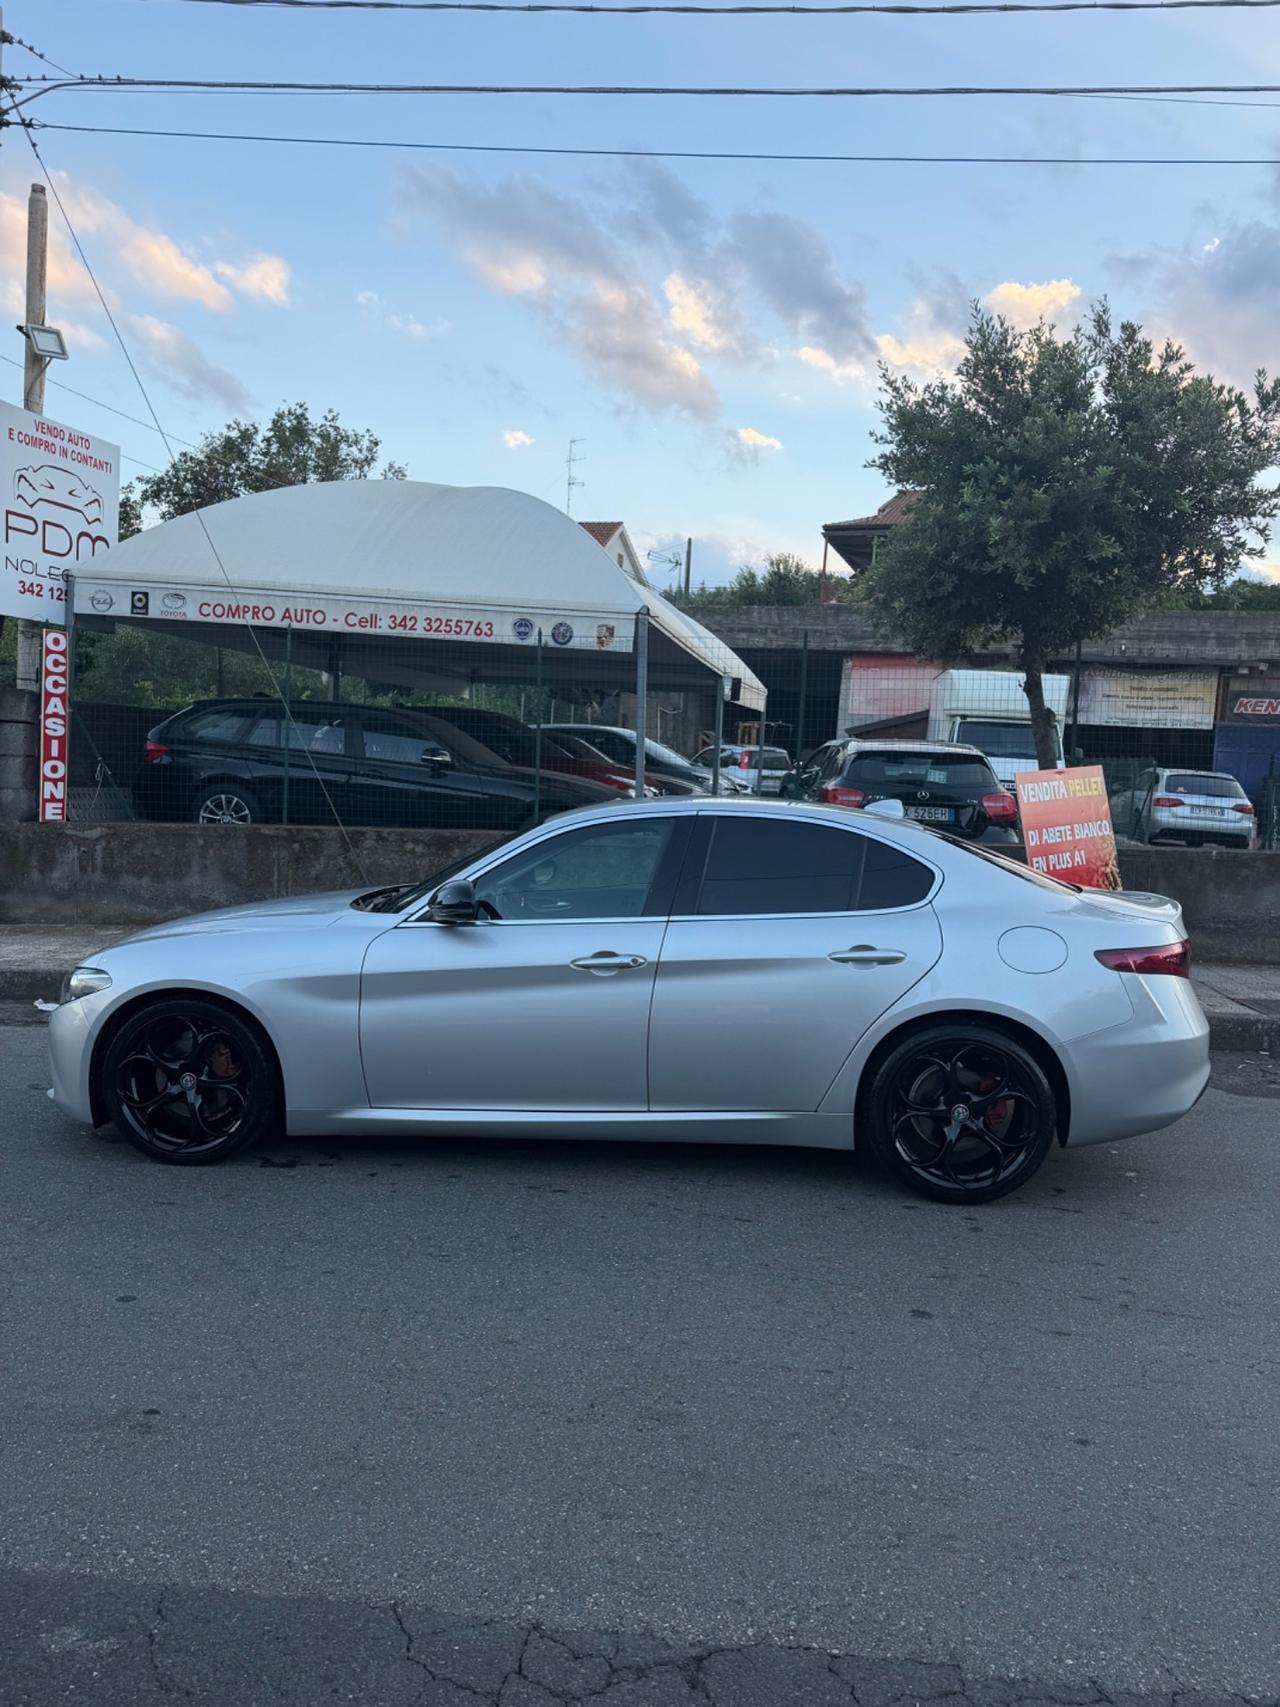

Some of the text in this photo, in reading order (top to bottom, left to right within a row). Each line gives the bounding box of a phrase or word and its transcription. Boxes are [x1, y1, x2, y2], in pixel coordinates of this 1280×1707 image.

[34, 419, 91, 450] VENDO AUTO
[8, 427, 112, 474] E COMPRO IN CONTANTI
[18, 580, 43, 597] 342
[199, 602, 276, 621] COMPRO
[281, 607, 327, 625] AUTO
[344, 611, 383, 629] Cell:
[387, 614, 418, 632] 342
[423, 616, 494, 638] 3255763
[43, 632, 67, 820] OCCASIONE
[1020, 777, 1104, 803] VENDITA PELLET
[1028, 820, 1110, 846] DI ABETE BIANCO
[1032, 849, 1087, 873] EN PLUS A1
